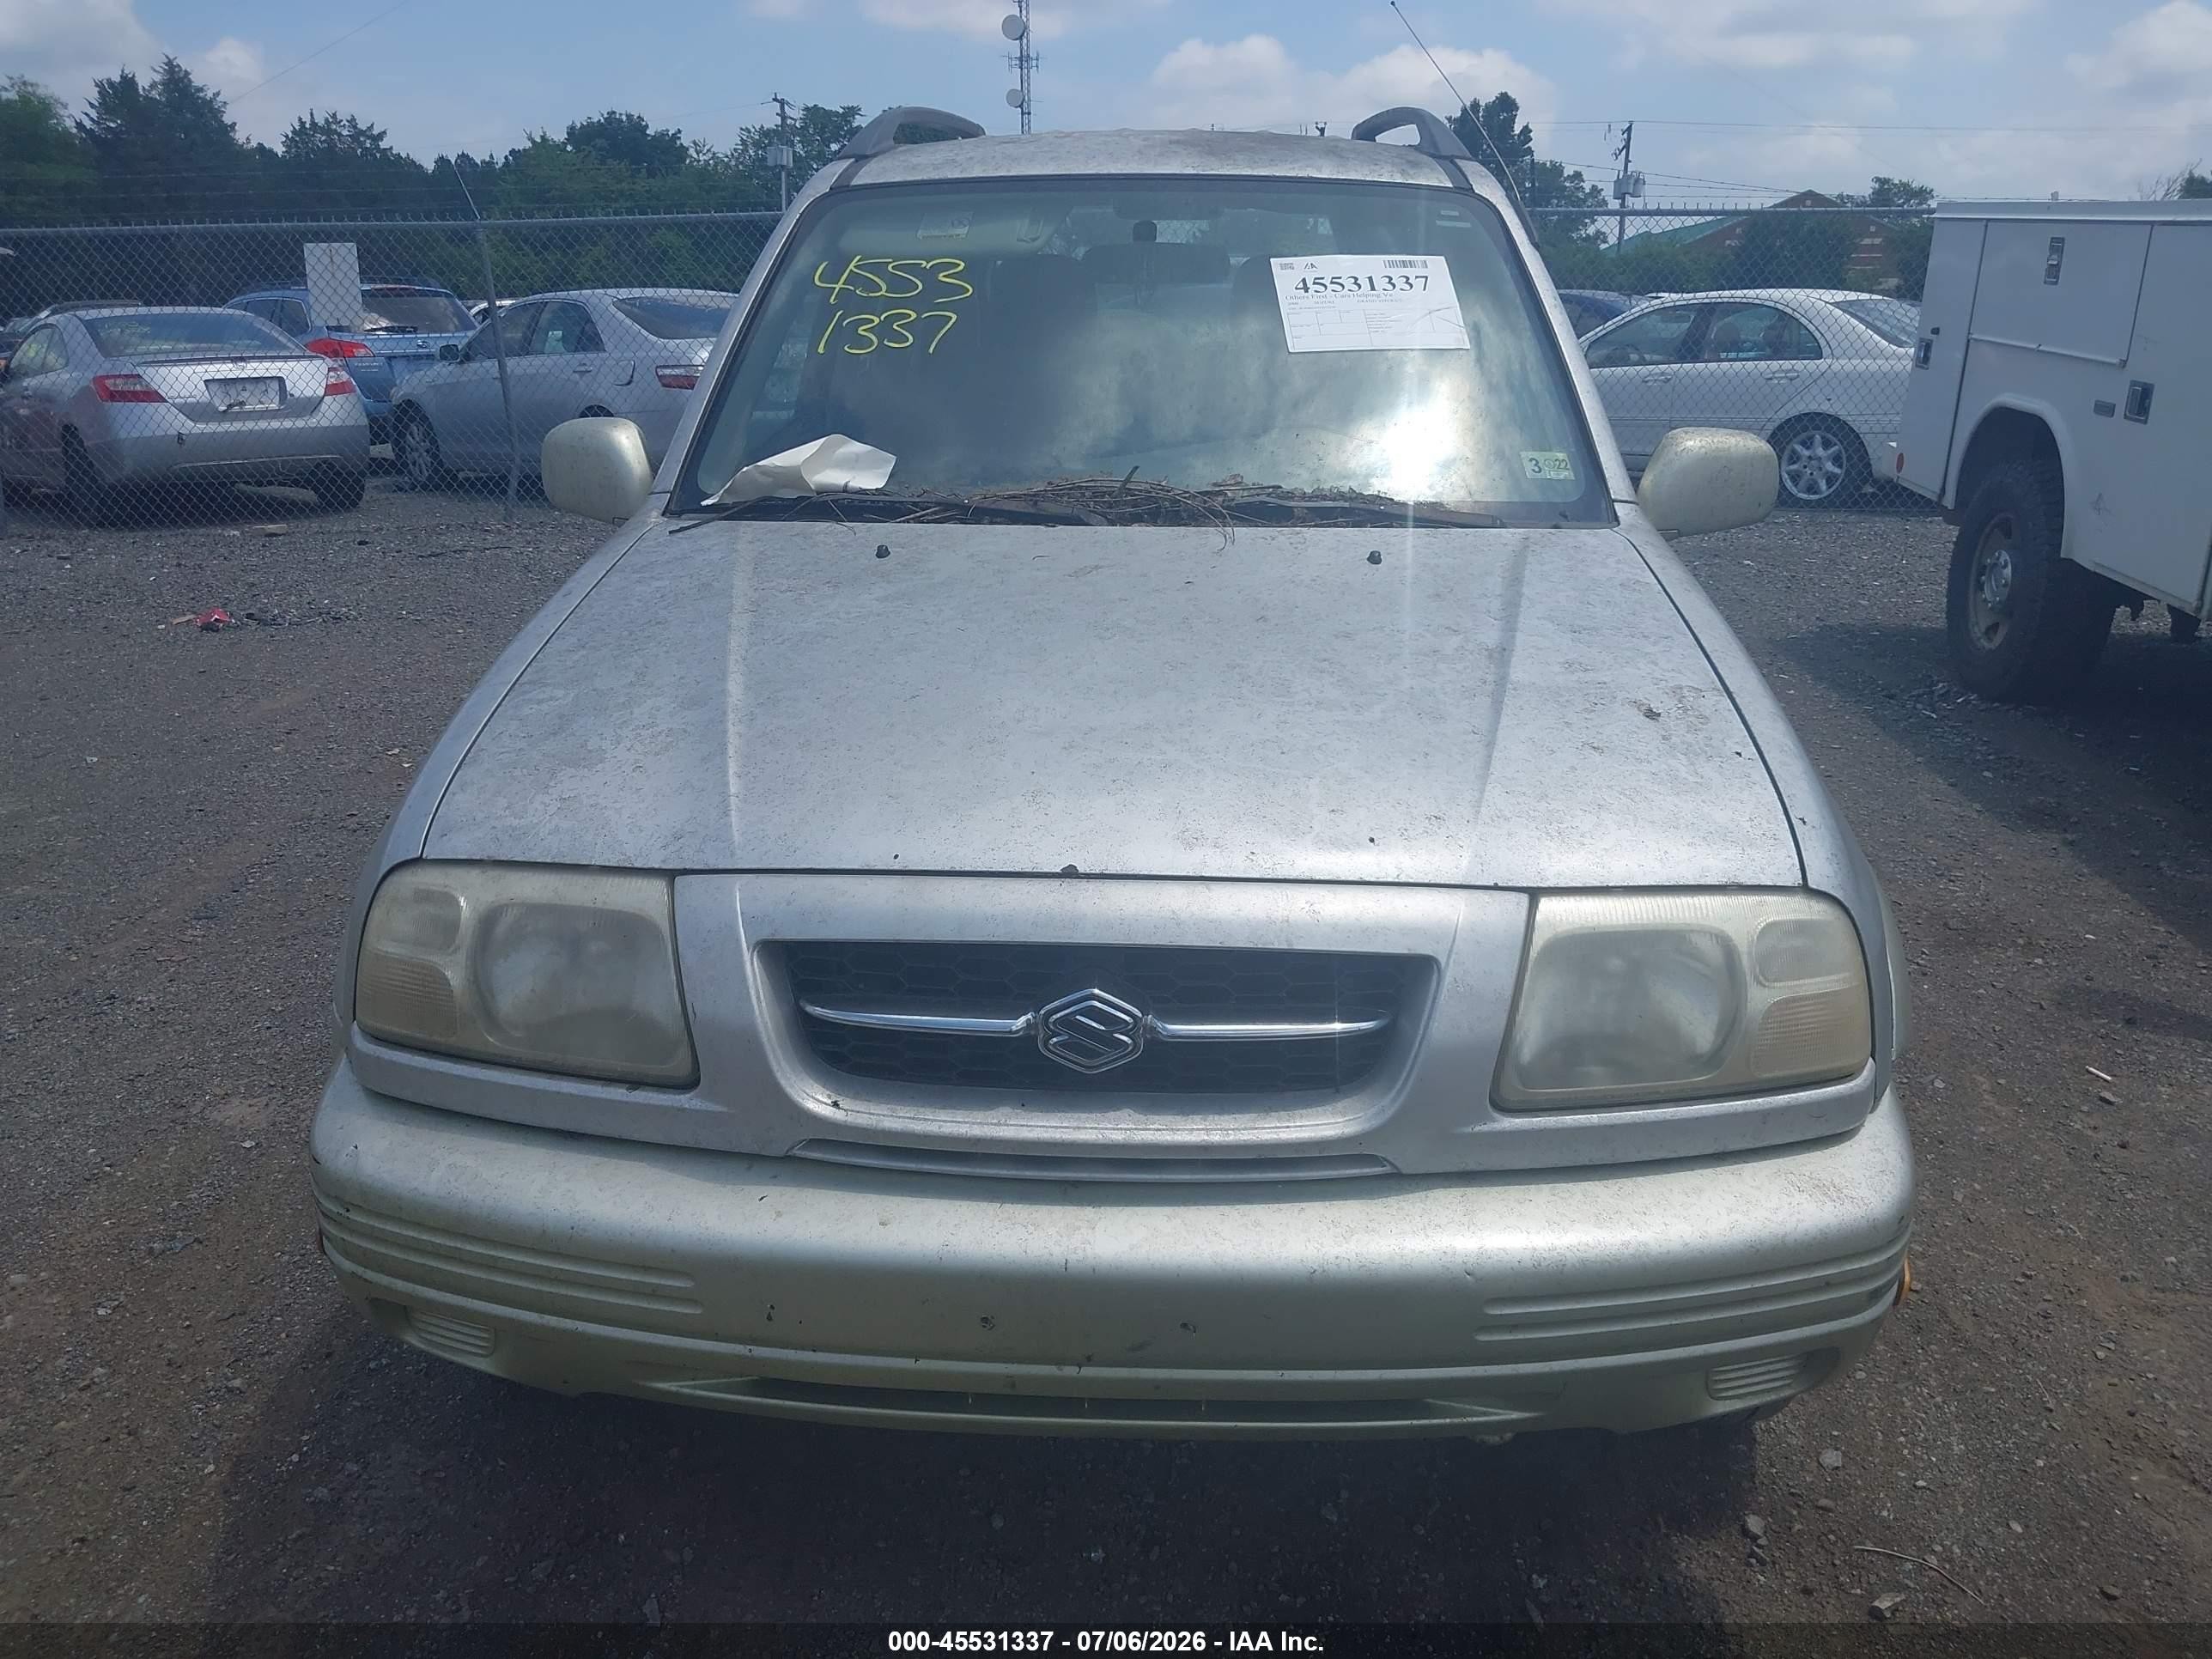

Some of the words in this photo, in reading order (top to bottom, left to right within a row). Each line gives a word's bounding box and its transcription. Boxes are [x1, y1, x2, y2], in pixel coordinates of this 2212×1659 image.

[814, 255, 974, 304] 4553
[1294, 275, 1429, 293] 45531337
[817, 308, 958, 354] 1337
[1528, 458, 1542, 473] 3
